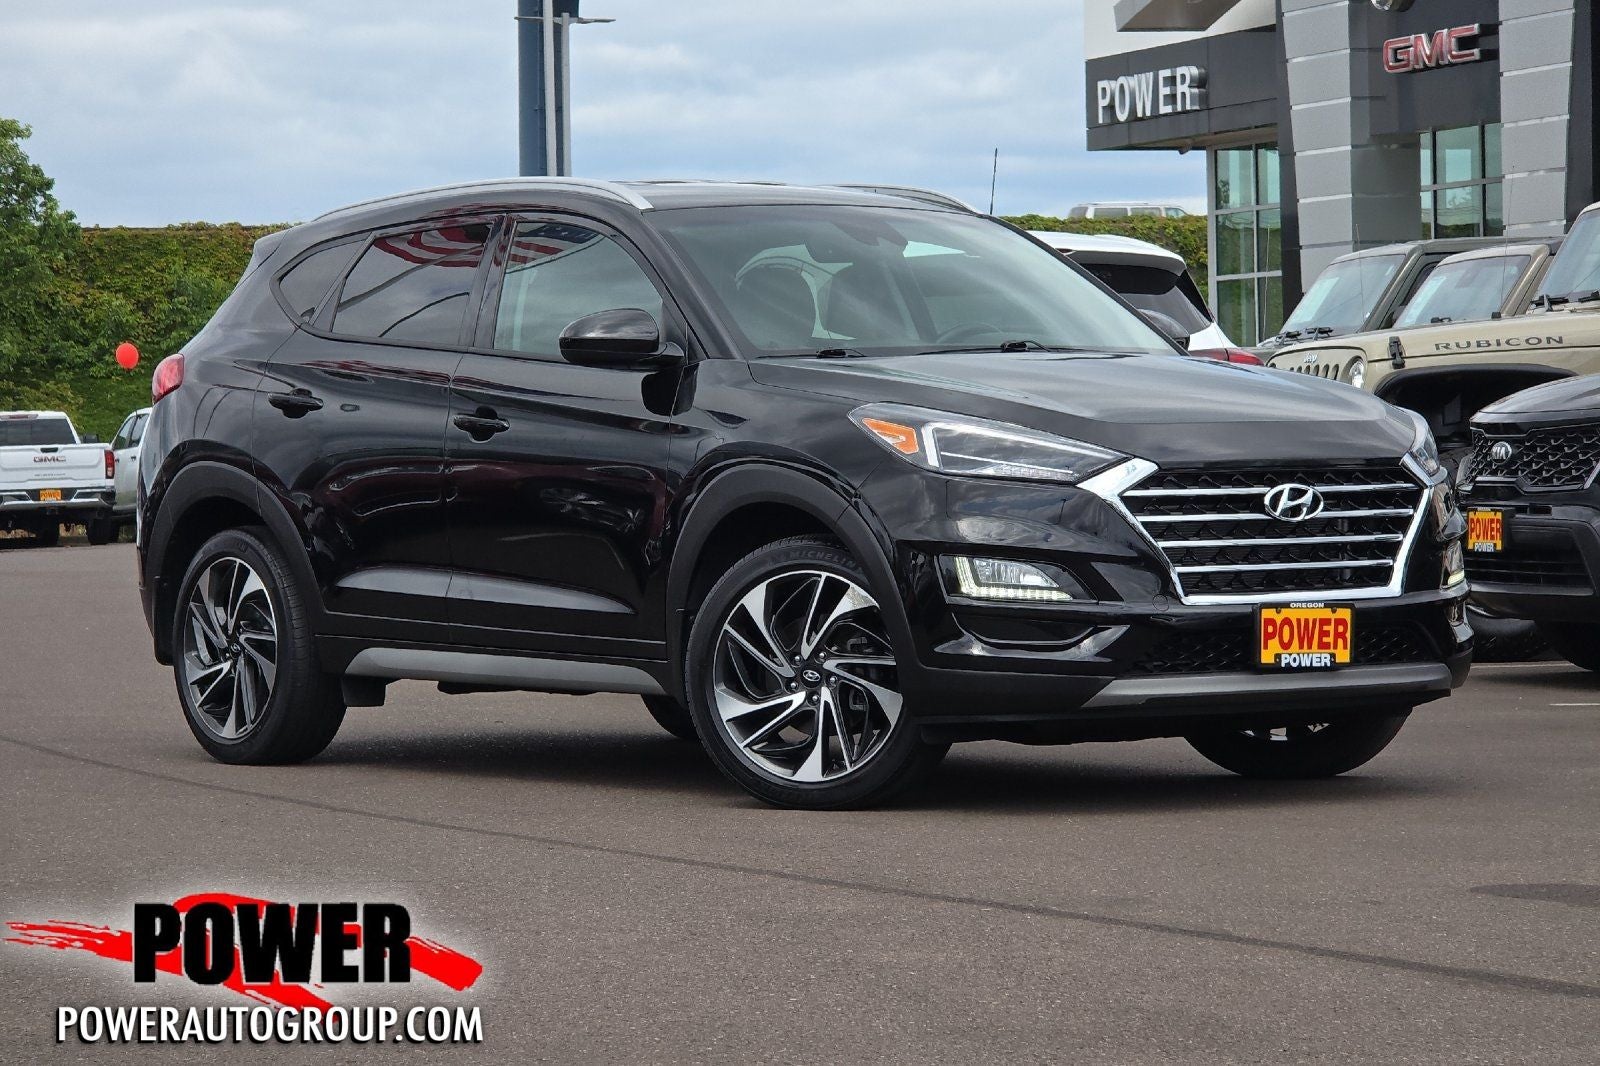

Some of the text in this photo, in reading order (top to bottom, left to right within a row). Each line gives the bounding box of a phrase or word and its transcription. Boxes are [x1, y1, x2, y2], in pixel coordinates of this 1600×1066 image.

[1382, 23, 1481, 73] GMC
[1097, 65, 1198, 124] POWER
[1435, 336, 1563, 350] RUBICON
[33, 455, 66, 463] GMC
[1469, 517, 1502, 541] POWER
[1474, 542, 1494, 552] POWER
[790, 551, 856, 568] MICHELIN
[1263, 617, 1348, 650] POWER
[1280, 653, 1331, 667] POWER
